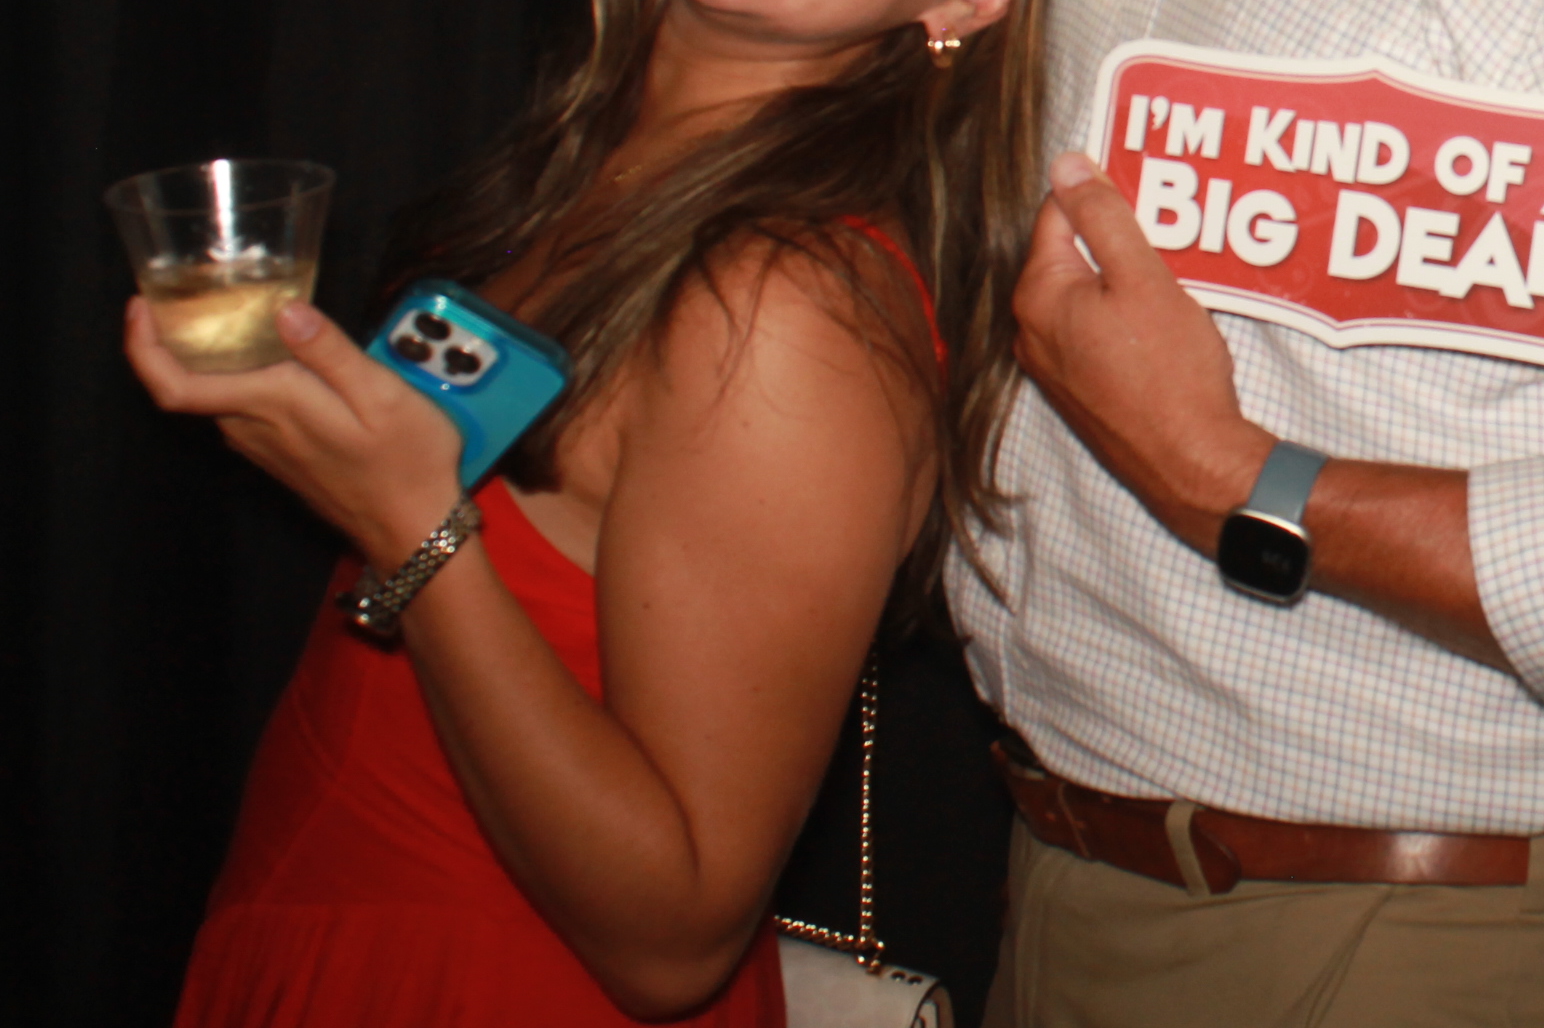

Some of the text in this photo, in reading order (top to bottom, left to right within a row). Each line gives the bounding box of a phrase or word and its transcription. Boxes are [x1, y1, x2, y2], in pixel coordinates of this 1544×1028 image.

[1124, 94, 1225, 160] I'M
[1434, 135, 1532, 203] OF
[1135, 157, 1298, 266] BIG
